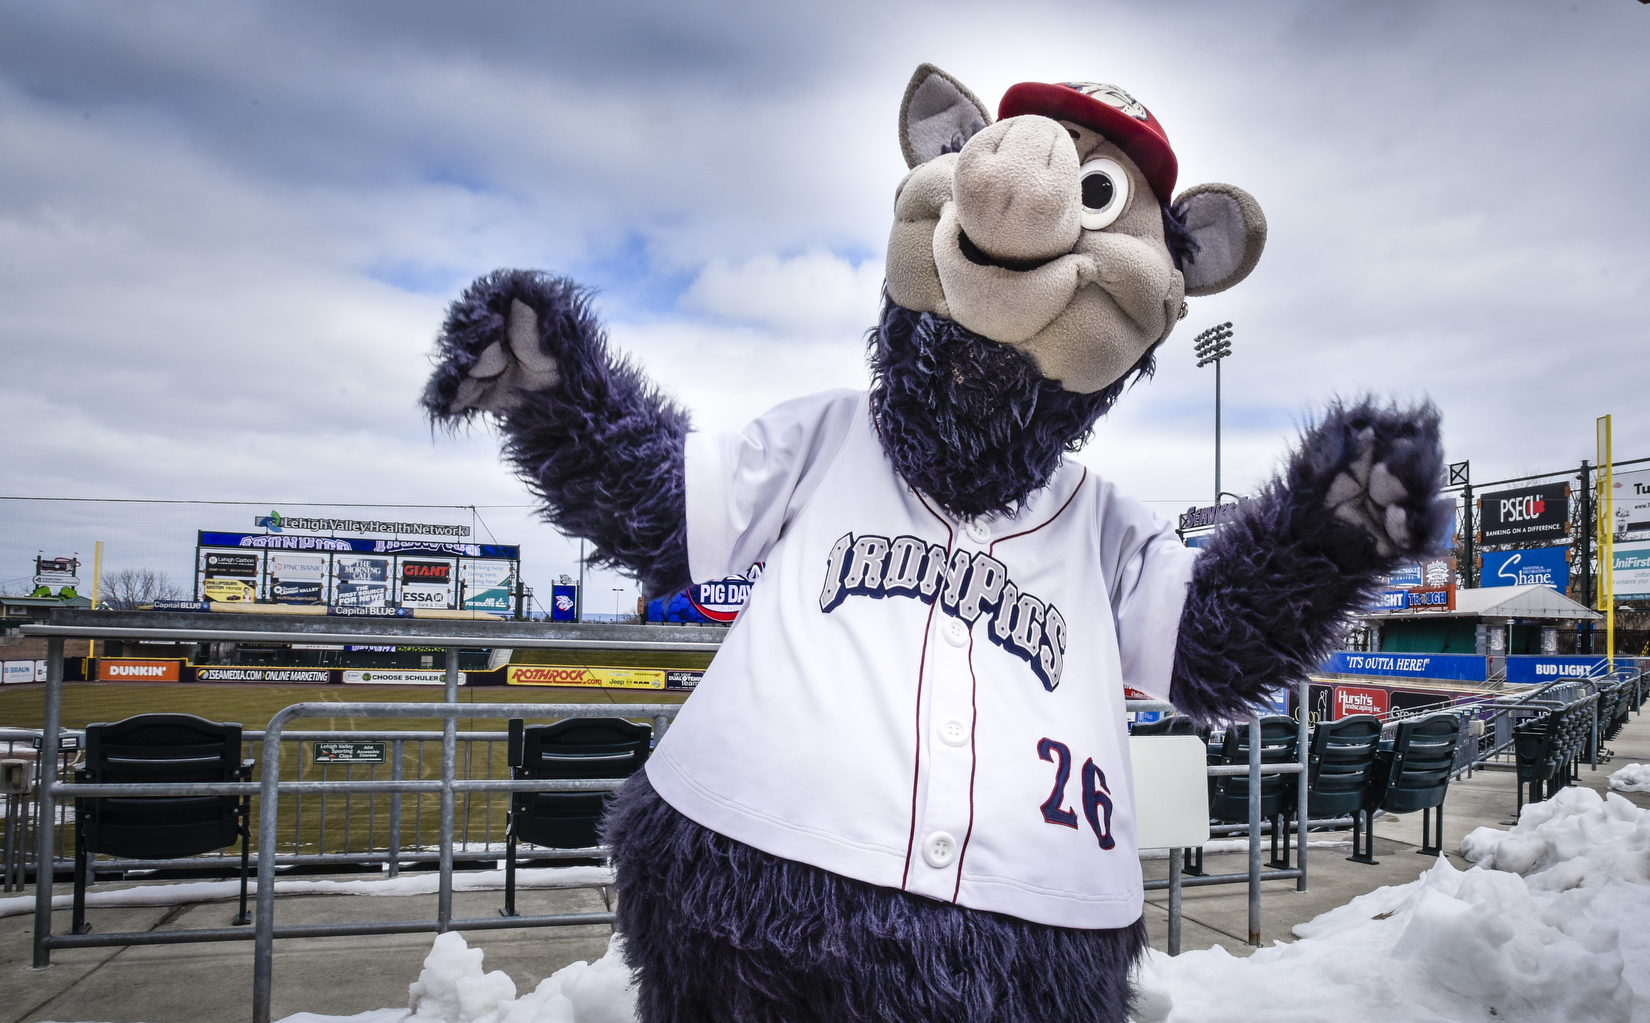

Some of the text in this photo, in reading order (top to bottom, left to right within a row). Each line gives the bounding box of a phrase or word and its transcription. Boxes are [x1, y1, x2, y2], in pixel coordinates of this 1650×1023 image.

[1500, 494, 1541, 523] PSECU
[284, 517, 467, 537] Lehigh Valley Health Network
[1486, 529, 1511, 537] BANKING
[1528, 523, 1562, 533] DIFFERENCE.
[283, 563, 321, 572] PNC BANK
[344, 566, 381, 574] MORNING
[403, 565, 450, 578] GIANT
[358, 588, 385, 596] SOURCE
[402, 592, 431, 602] ESSA
[700, 584, 726, 603] PIG
[1408, 591, 1447, 606] TRUGH
[154, 601, 180, 609] Capital
[338, 594, 385, 606] FOR NEWS
[335, 606, 370, 617] Capital
[819, 531, 1067, 693] IRONPIGS
[1346, 655, 1364, 669] "IT'S
[1364, 657, 1394, 671] OUTTA
[10, 666, 30, 674] BRAUN
[109, 664, 167, 677] DUNKIN'
[208, 670, 328, 682] ISEAMEDIA.COM ONLINE MARKETING
[1535, 664, 1592, 677] BUD LIGHT
[371, 673, 439, 682] CHOOSE SCHULER
[608, 679, 625, 687] Jeep
[1338, 690, 1374, 706] Hursh's
[1037, 737, 1115, 850] 26
